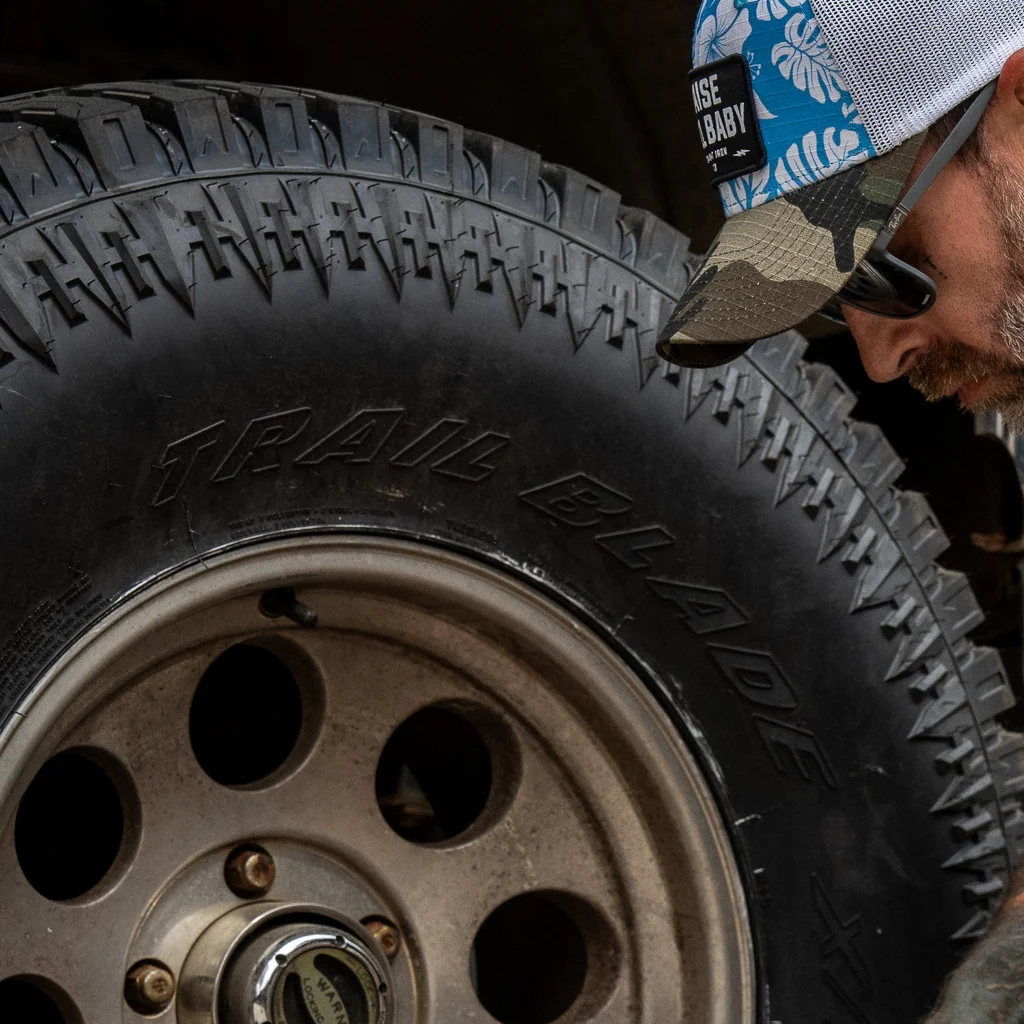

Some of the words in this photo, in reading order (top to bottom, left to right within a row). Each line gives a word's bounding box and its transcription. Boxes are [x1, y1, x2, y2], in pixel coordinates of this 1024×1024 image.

[703, 102, 746, 145] BABY
[151, 406, 511, 508] TRAIL
[517, 471, 840, 789] BLADE
[303, 977, 325, 1024] LOCKING
